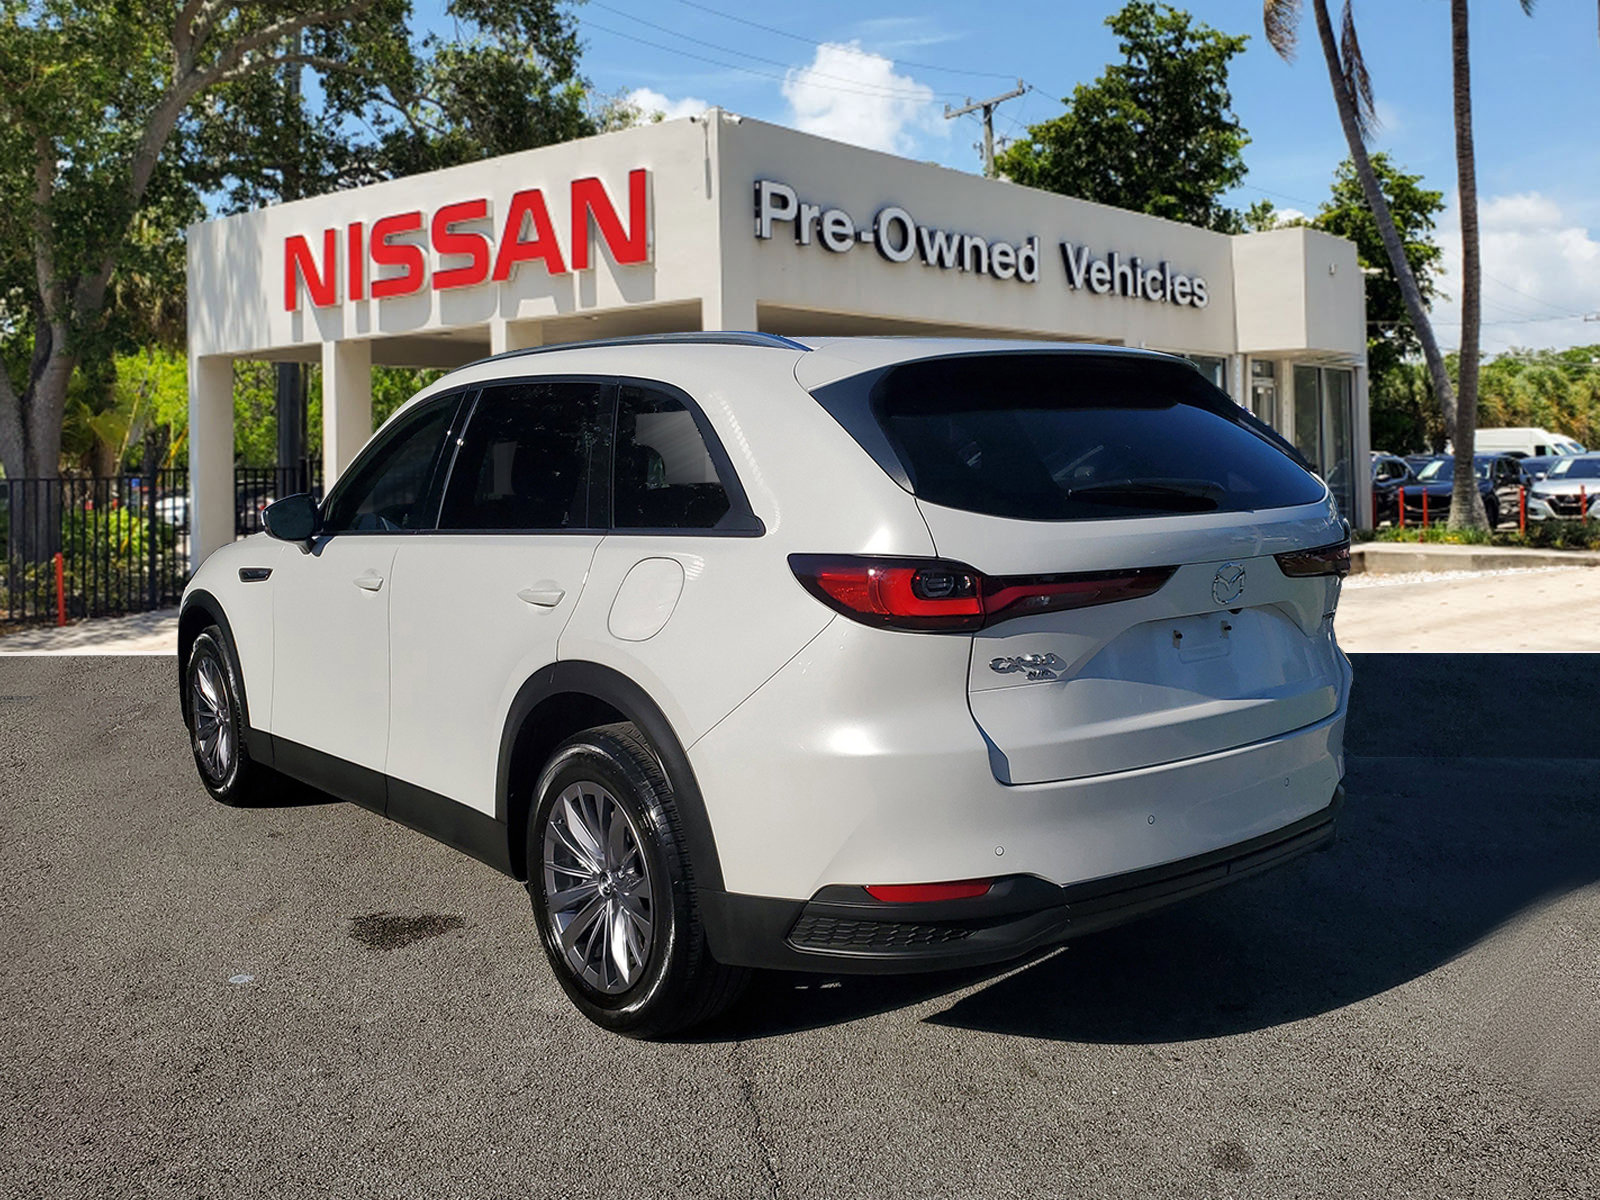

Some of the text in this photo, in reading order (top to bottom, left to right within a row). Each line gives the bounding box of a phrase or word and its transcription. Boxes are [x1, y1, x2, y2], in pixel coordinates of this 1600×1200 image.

[284, 168, 648, 312] NISSAN
[754, 179, 1209, 309] Pre-Owned Vehicles
